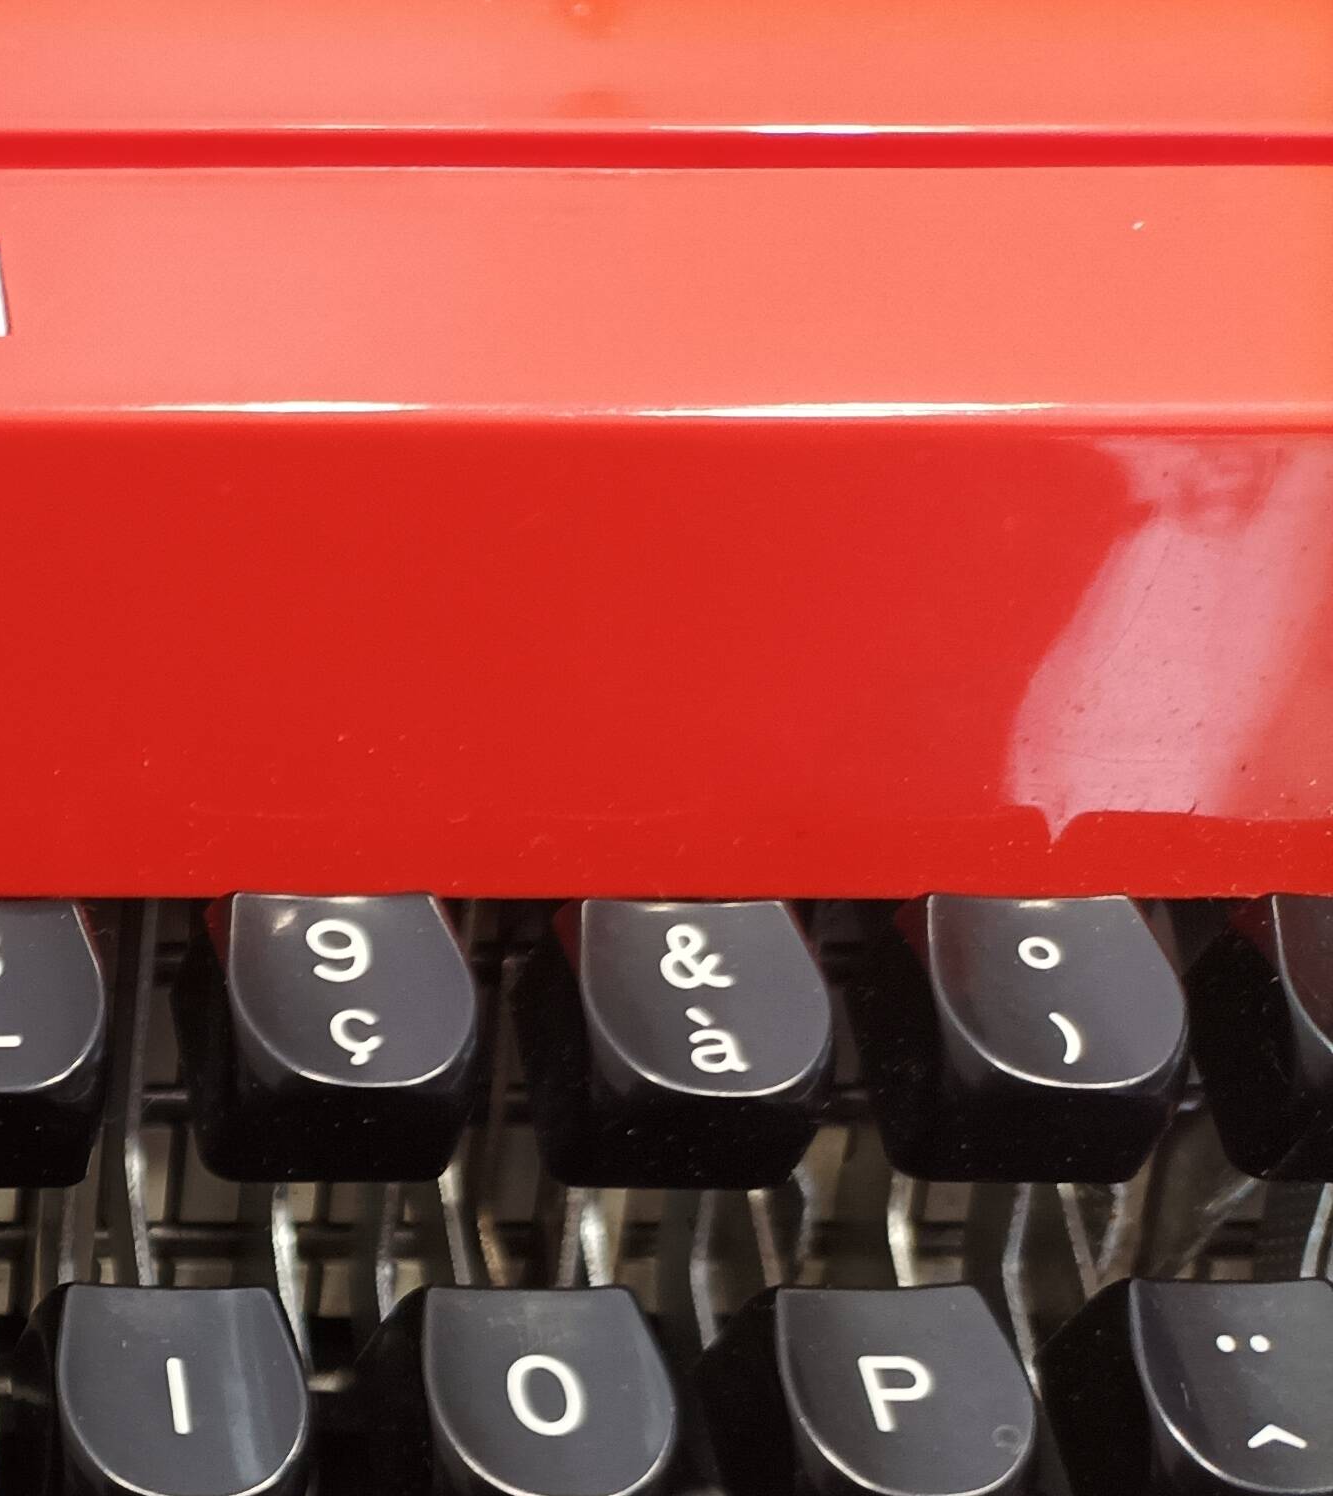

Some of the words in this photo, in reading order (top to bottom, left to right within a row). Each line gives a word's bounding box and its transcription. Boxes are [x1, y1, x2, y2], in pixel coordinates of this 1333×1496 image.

[304, 917, 372, 984] 9
[659, 922, 735, 990] &
[328, 1008, 384, 1067] ç
[684, 1006, 743, 1075] à
[1047, 1011, 1083, 1066] )
[165, 1356, 192, 1436] I
[505, 1353, 585, 1437] O
[856, 1354, 934, 1433] P
